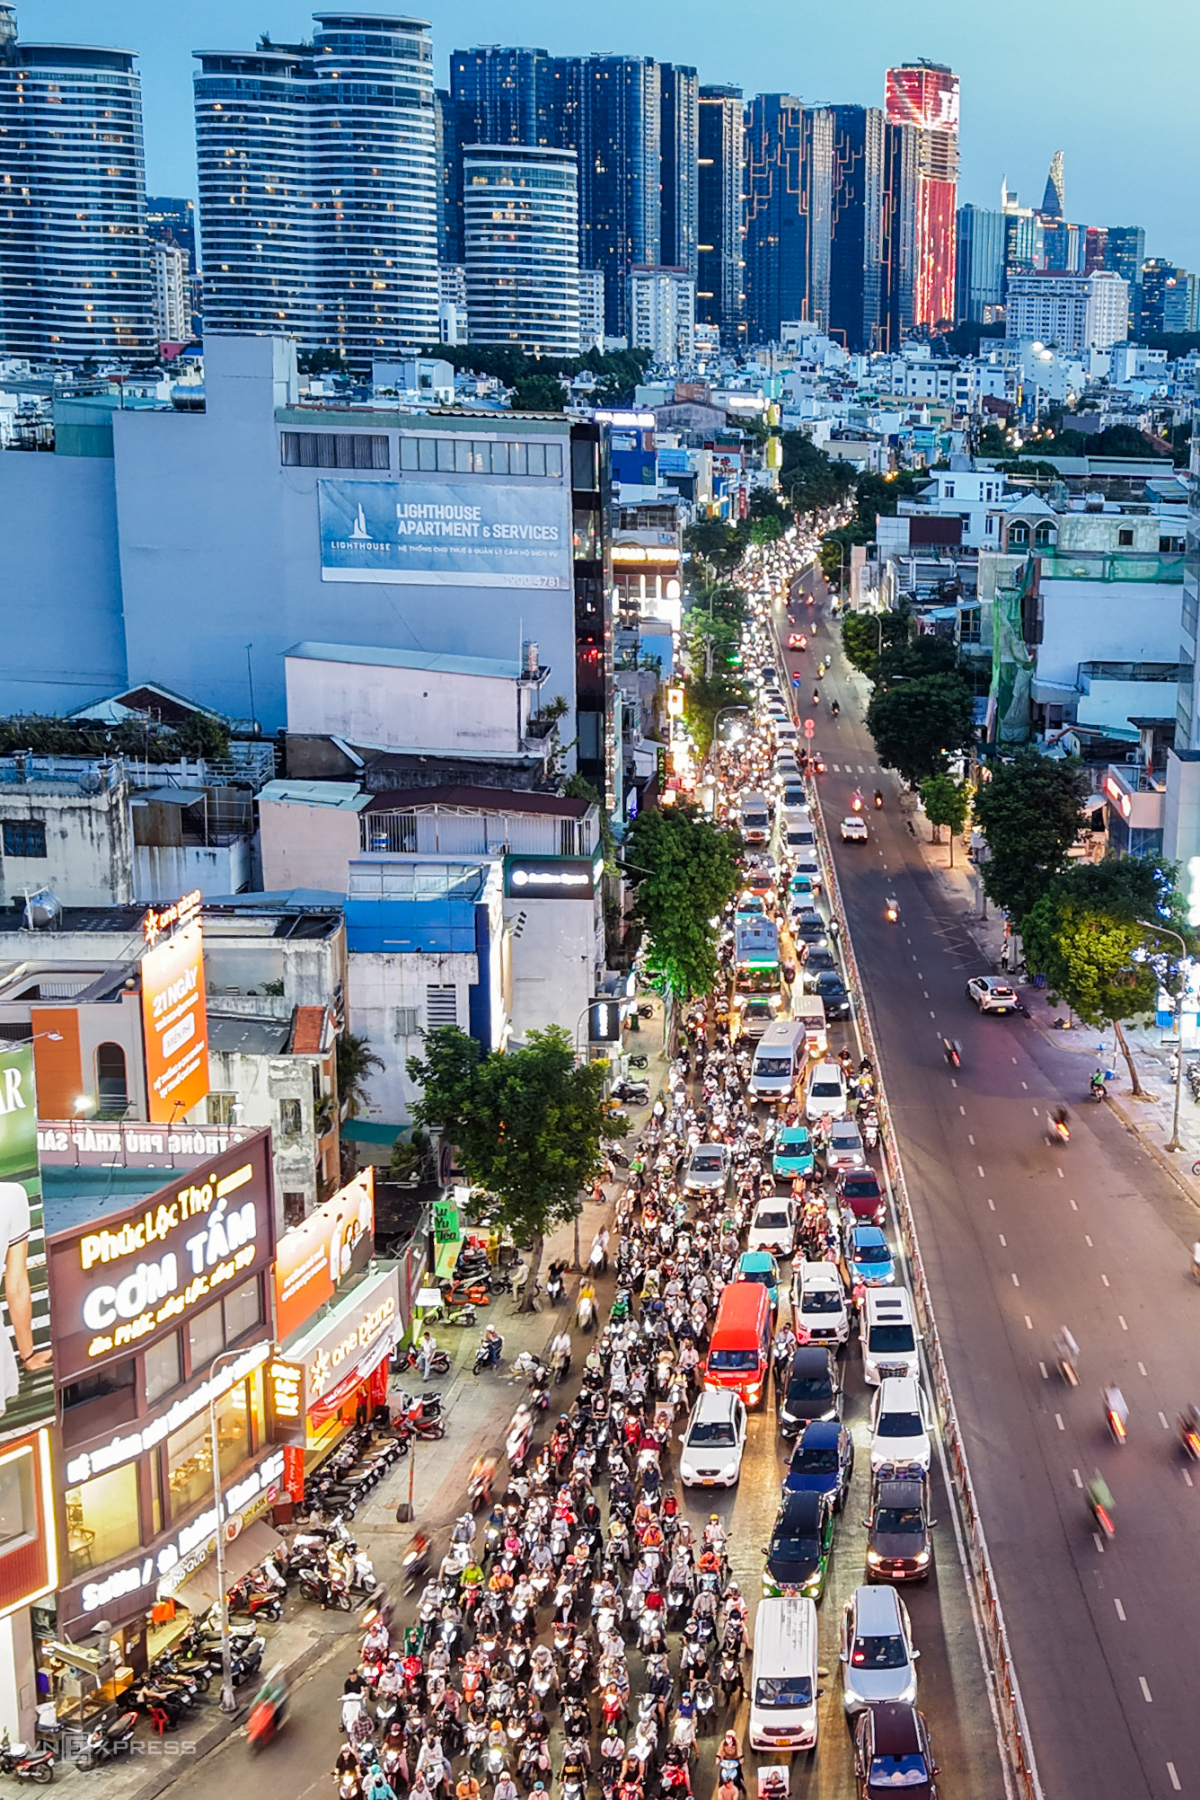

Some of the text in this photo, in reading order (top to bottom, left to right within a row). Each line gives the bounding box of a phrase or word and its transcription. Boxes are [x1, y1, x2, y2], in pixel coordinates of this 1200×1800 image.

[396, 503, 481, 522] LIGHTHOUSE
[397, 520, 559, 541] APARTMENT & SERVICES
[330, 541, 392, 551] LIGHTHOUSE
[534, 577, 560, 587] 4781
[80, 1223, 146, 1269] Phúc
[145, 1204, 179, 1243] Lộc
[185, 1197, 257, 1274] TẤM
[437, 1229, 457, 1241] Tea
[331, 1331, 358, 1367] one
[357, 1296, 395, 1345] piano
